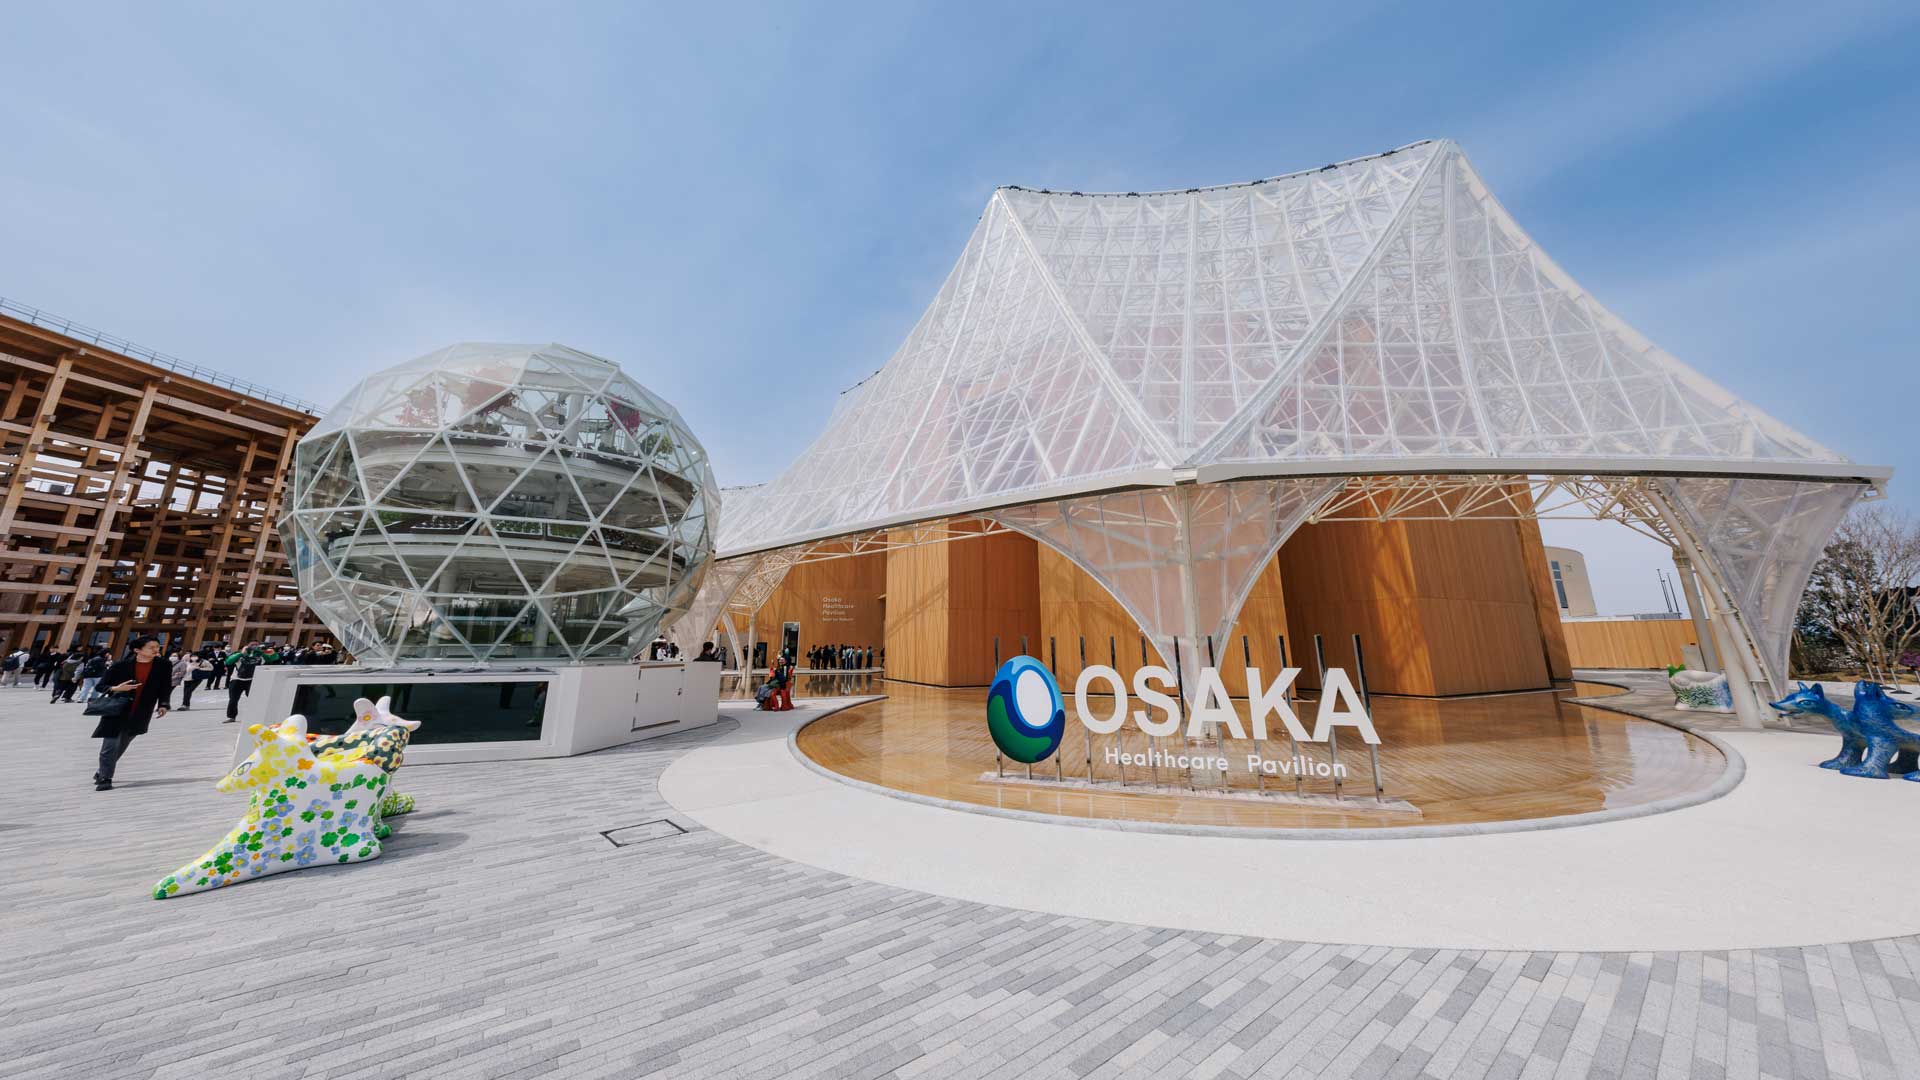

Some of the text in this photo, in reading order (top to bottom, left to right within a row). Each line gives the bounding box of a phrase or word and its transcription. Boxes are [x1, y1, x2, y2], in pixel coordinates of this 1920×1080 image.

[1074, 664, 1382, 744] OSAKA
[1104, 746, 1347, 778] Healthcare Pavilion
